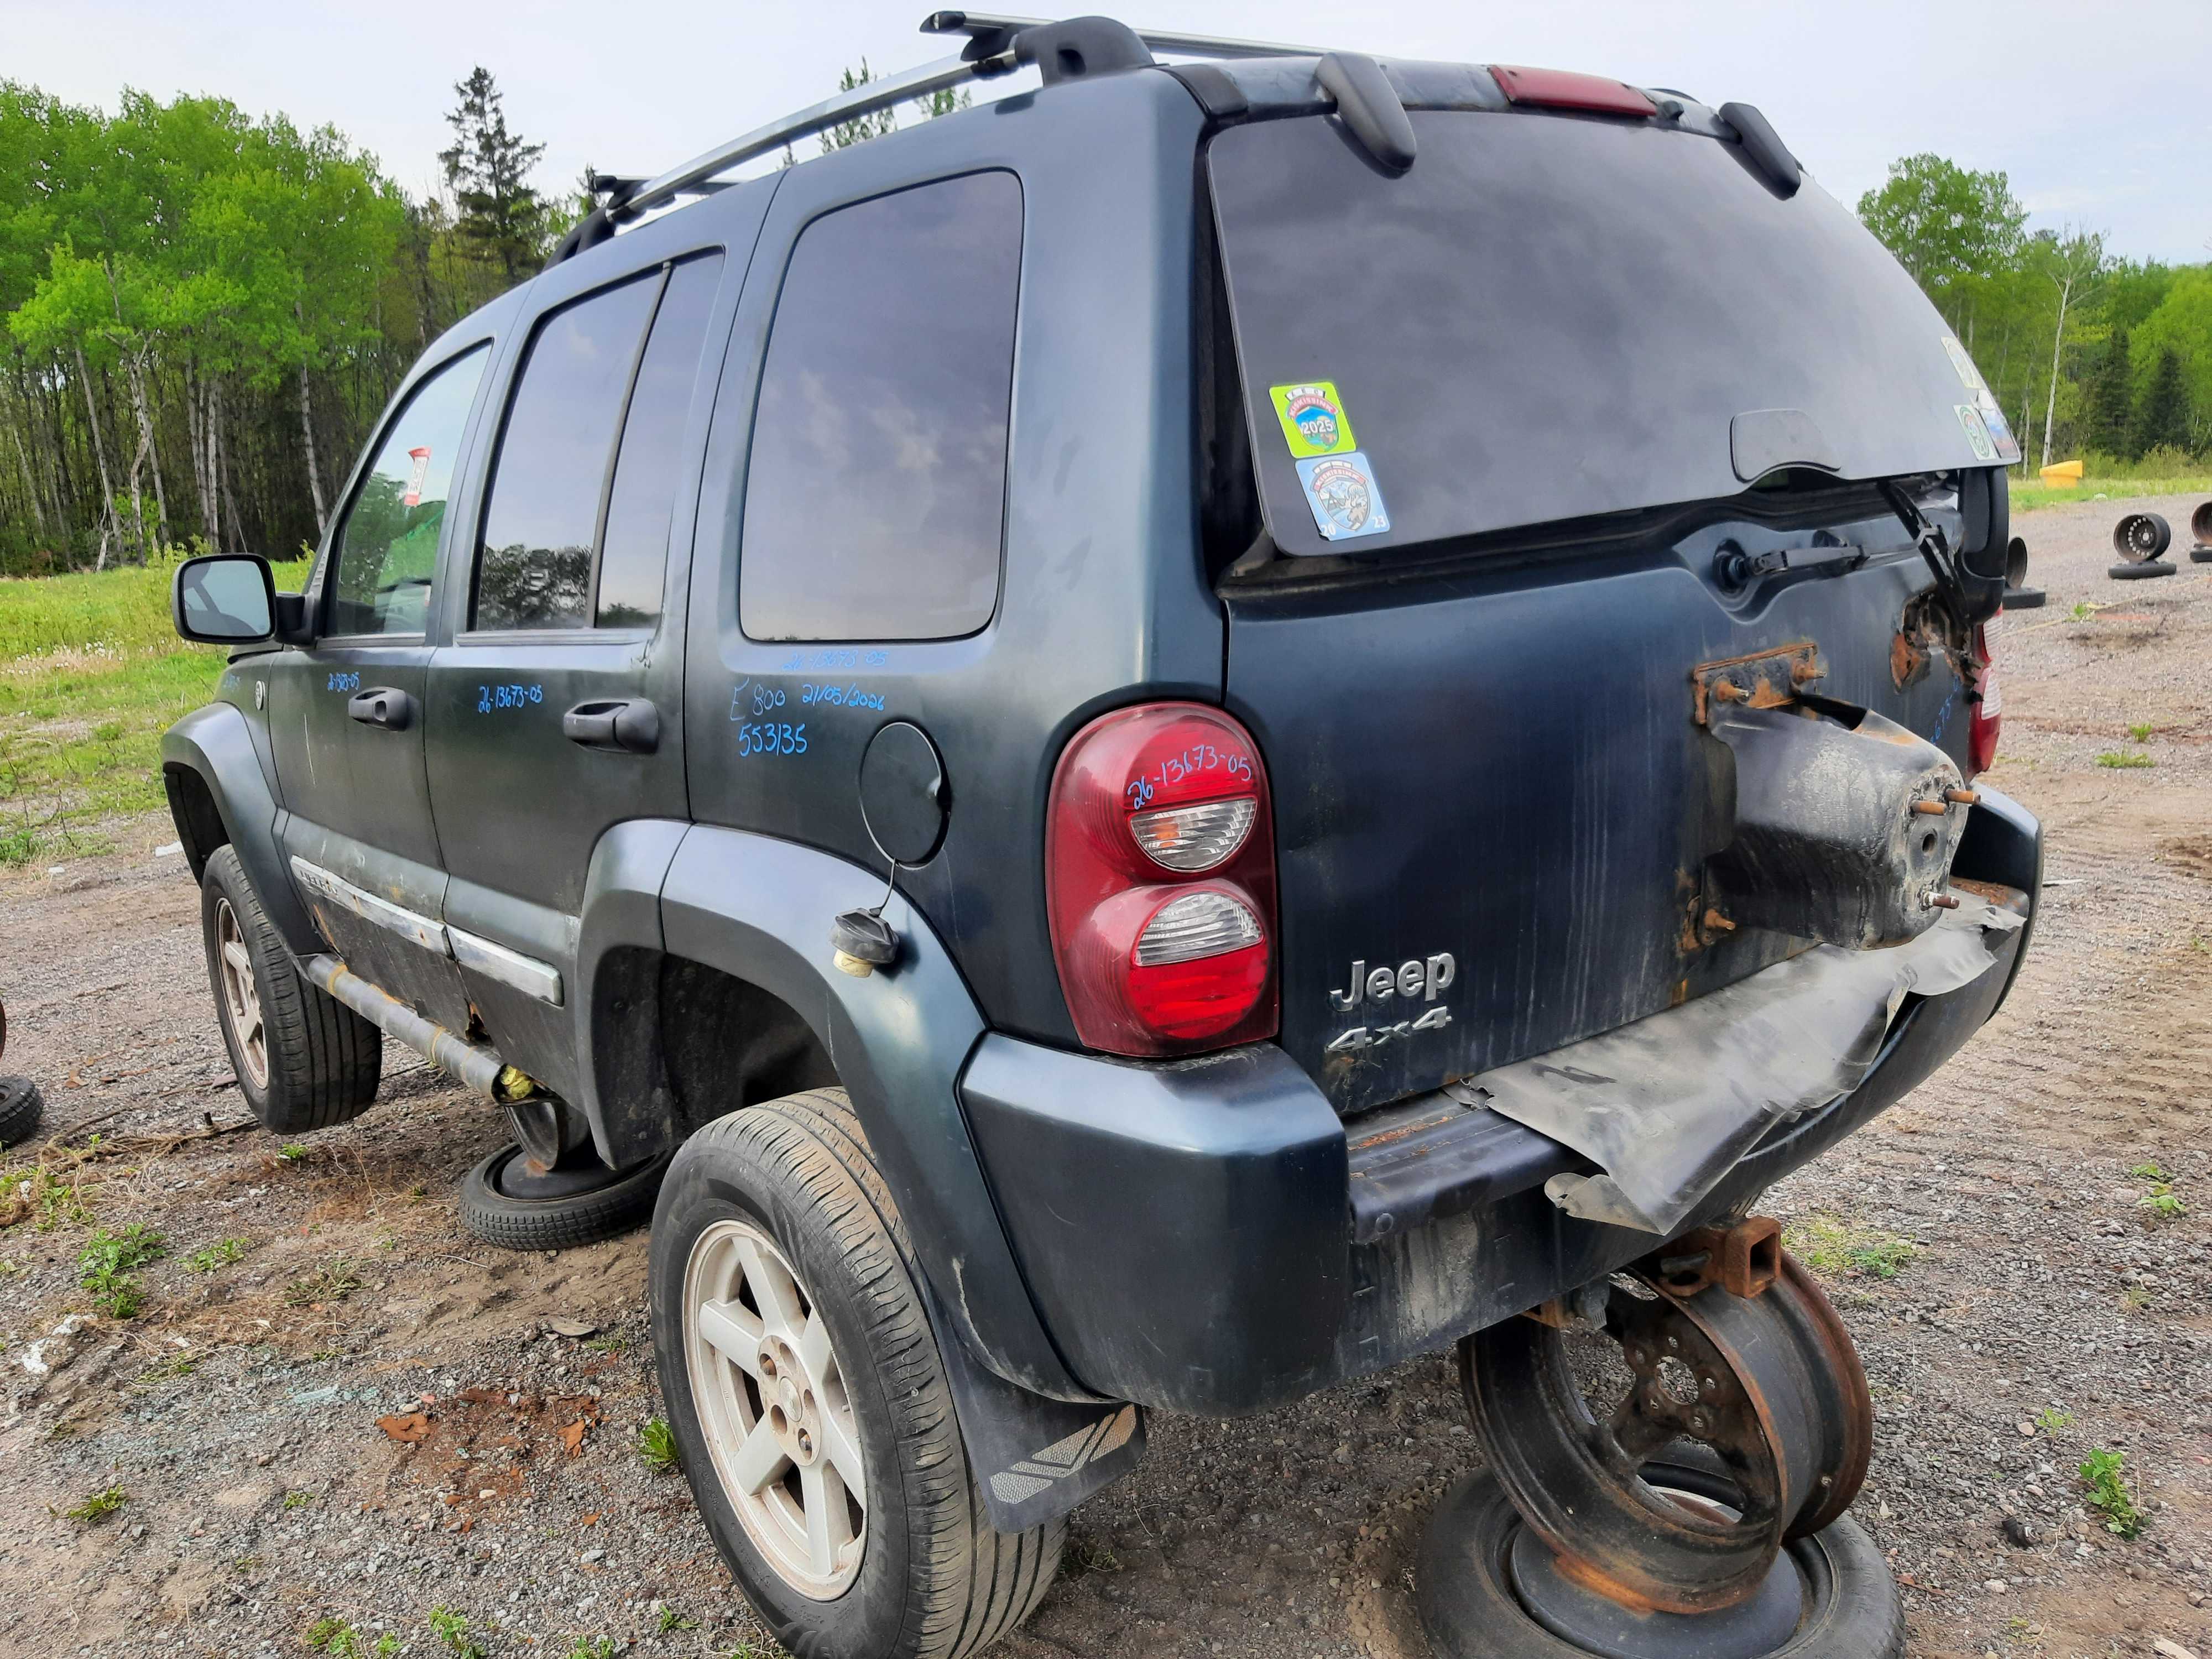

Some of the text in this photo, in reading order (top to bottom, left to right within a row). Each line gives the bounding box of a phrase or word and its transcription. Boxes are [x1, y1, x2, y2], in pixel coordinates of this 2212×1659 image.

[1301, 419, 1334, 434] 2025
[1321, 522, 1336, 537] 20
[802, 681, 885, 712] 21/05/2026
[1126, 744, 1252, 811] 26-13673-05
[1329, 952, 1455, 1013] Jeep
